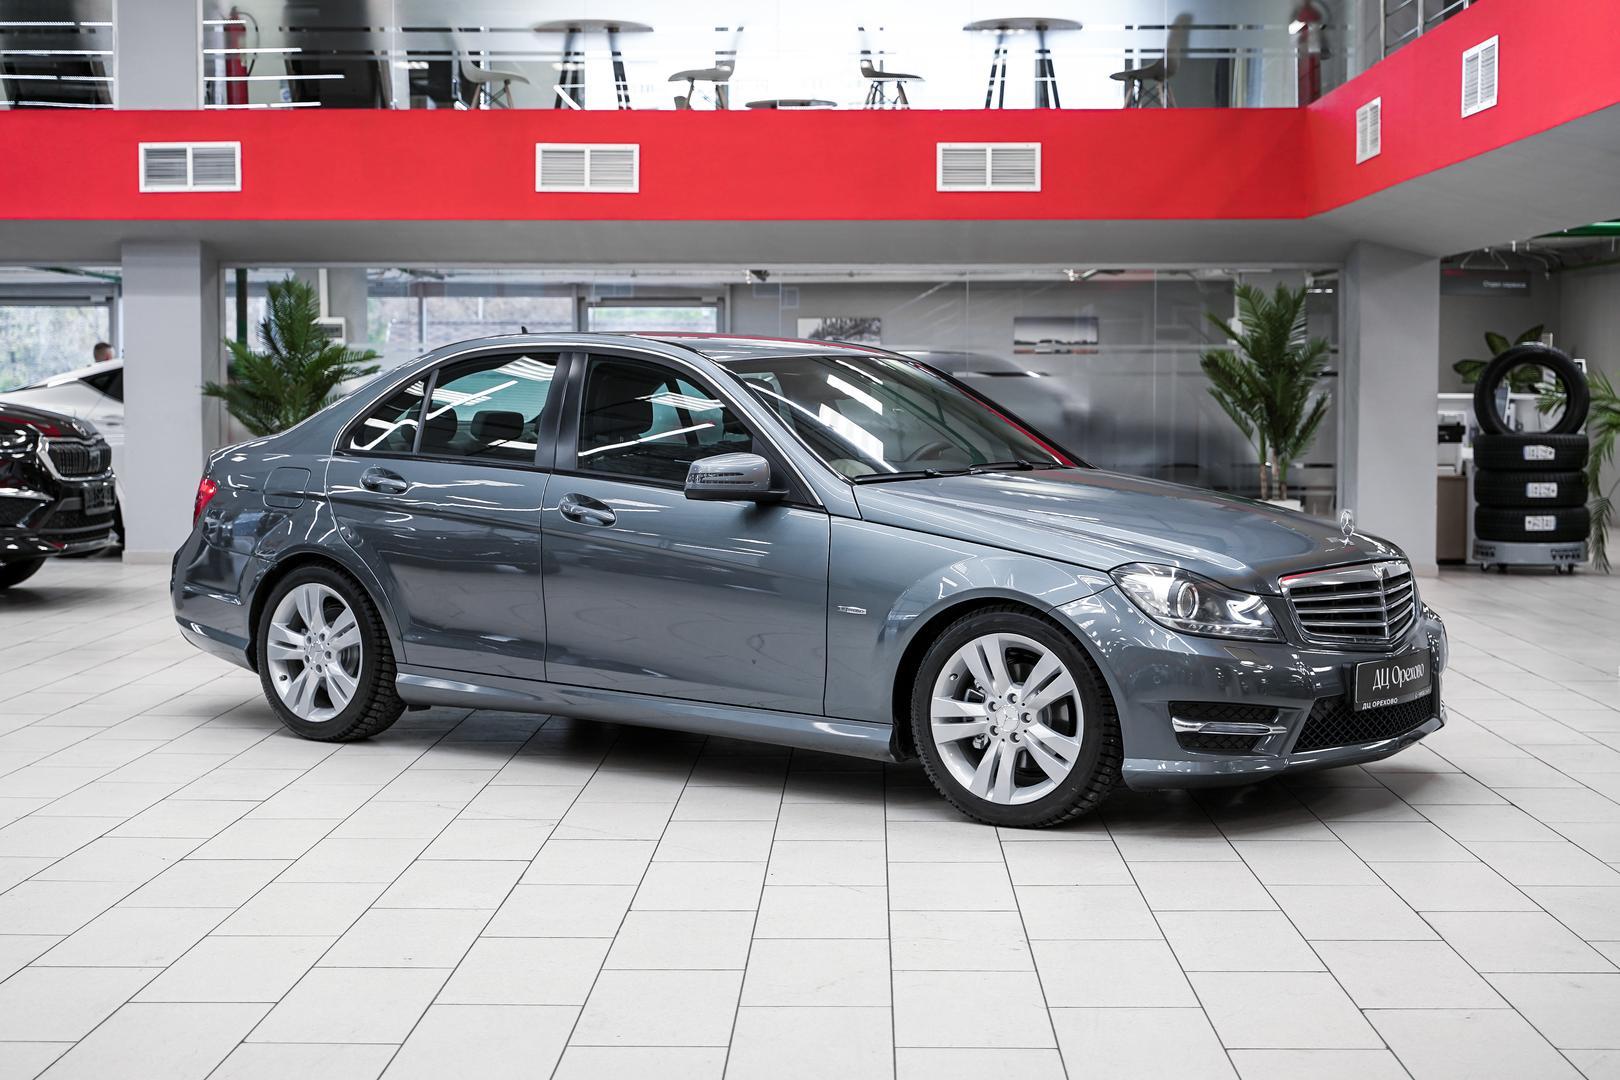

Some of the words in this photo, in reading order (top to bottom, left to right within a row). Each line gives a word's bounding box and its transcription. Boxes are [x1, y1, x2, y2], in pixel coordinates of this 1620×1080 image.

[1373, 667, 1390, 691] ДЦ
[1391, 663, 1425, 688] Орехово
[1362, 702, 1372, 710] ДЦ
[1372, 697, 1398, 708] ОРЕХОВО
